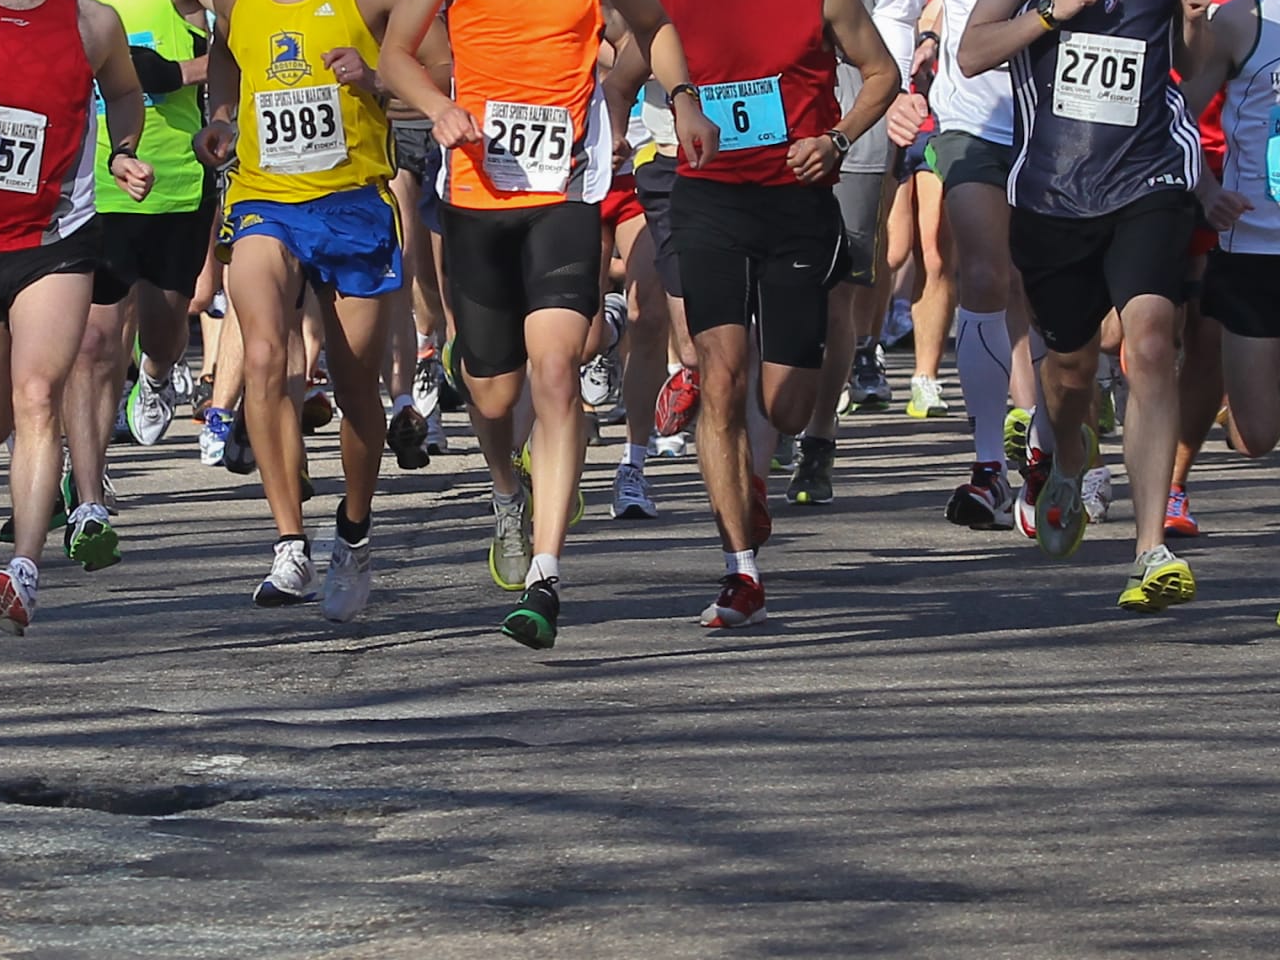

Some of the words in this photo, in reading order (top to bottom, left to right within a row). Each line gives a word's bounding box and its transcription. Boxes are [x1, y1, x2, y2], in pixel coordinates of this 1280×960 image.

[274, 61, 303, 71] BOSTON
[1061, 49, 1137, 91] 2705
[715, 84, 738, 100] SPORTS
[738, 81, 773, 98] MARATHON
[262, 104, 335, 145] 3983
[733, 100, 750, 133] 6
[488, 120, 566, 160] 2675
